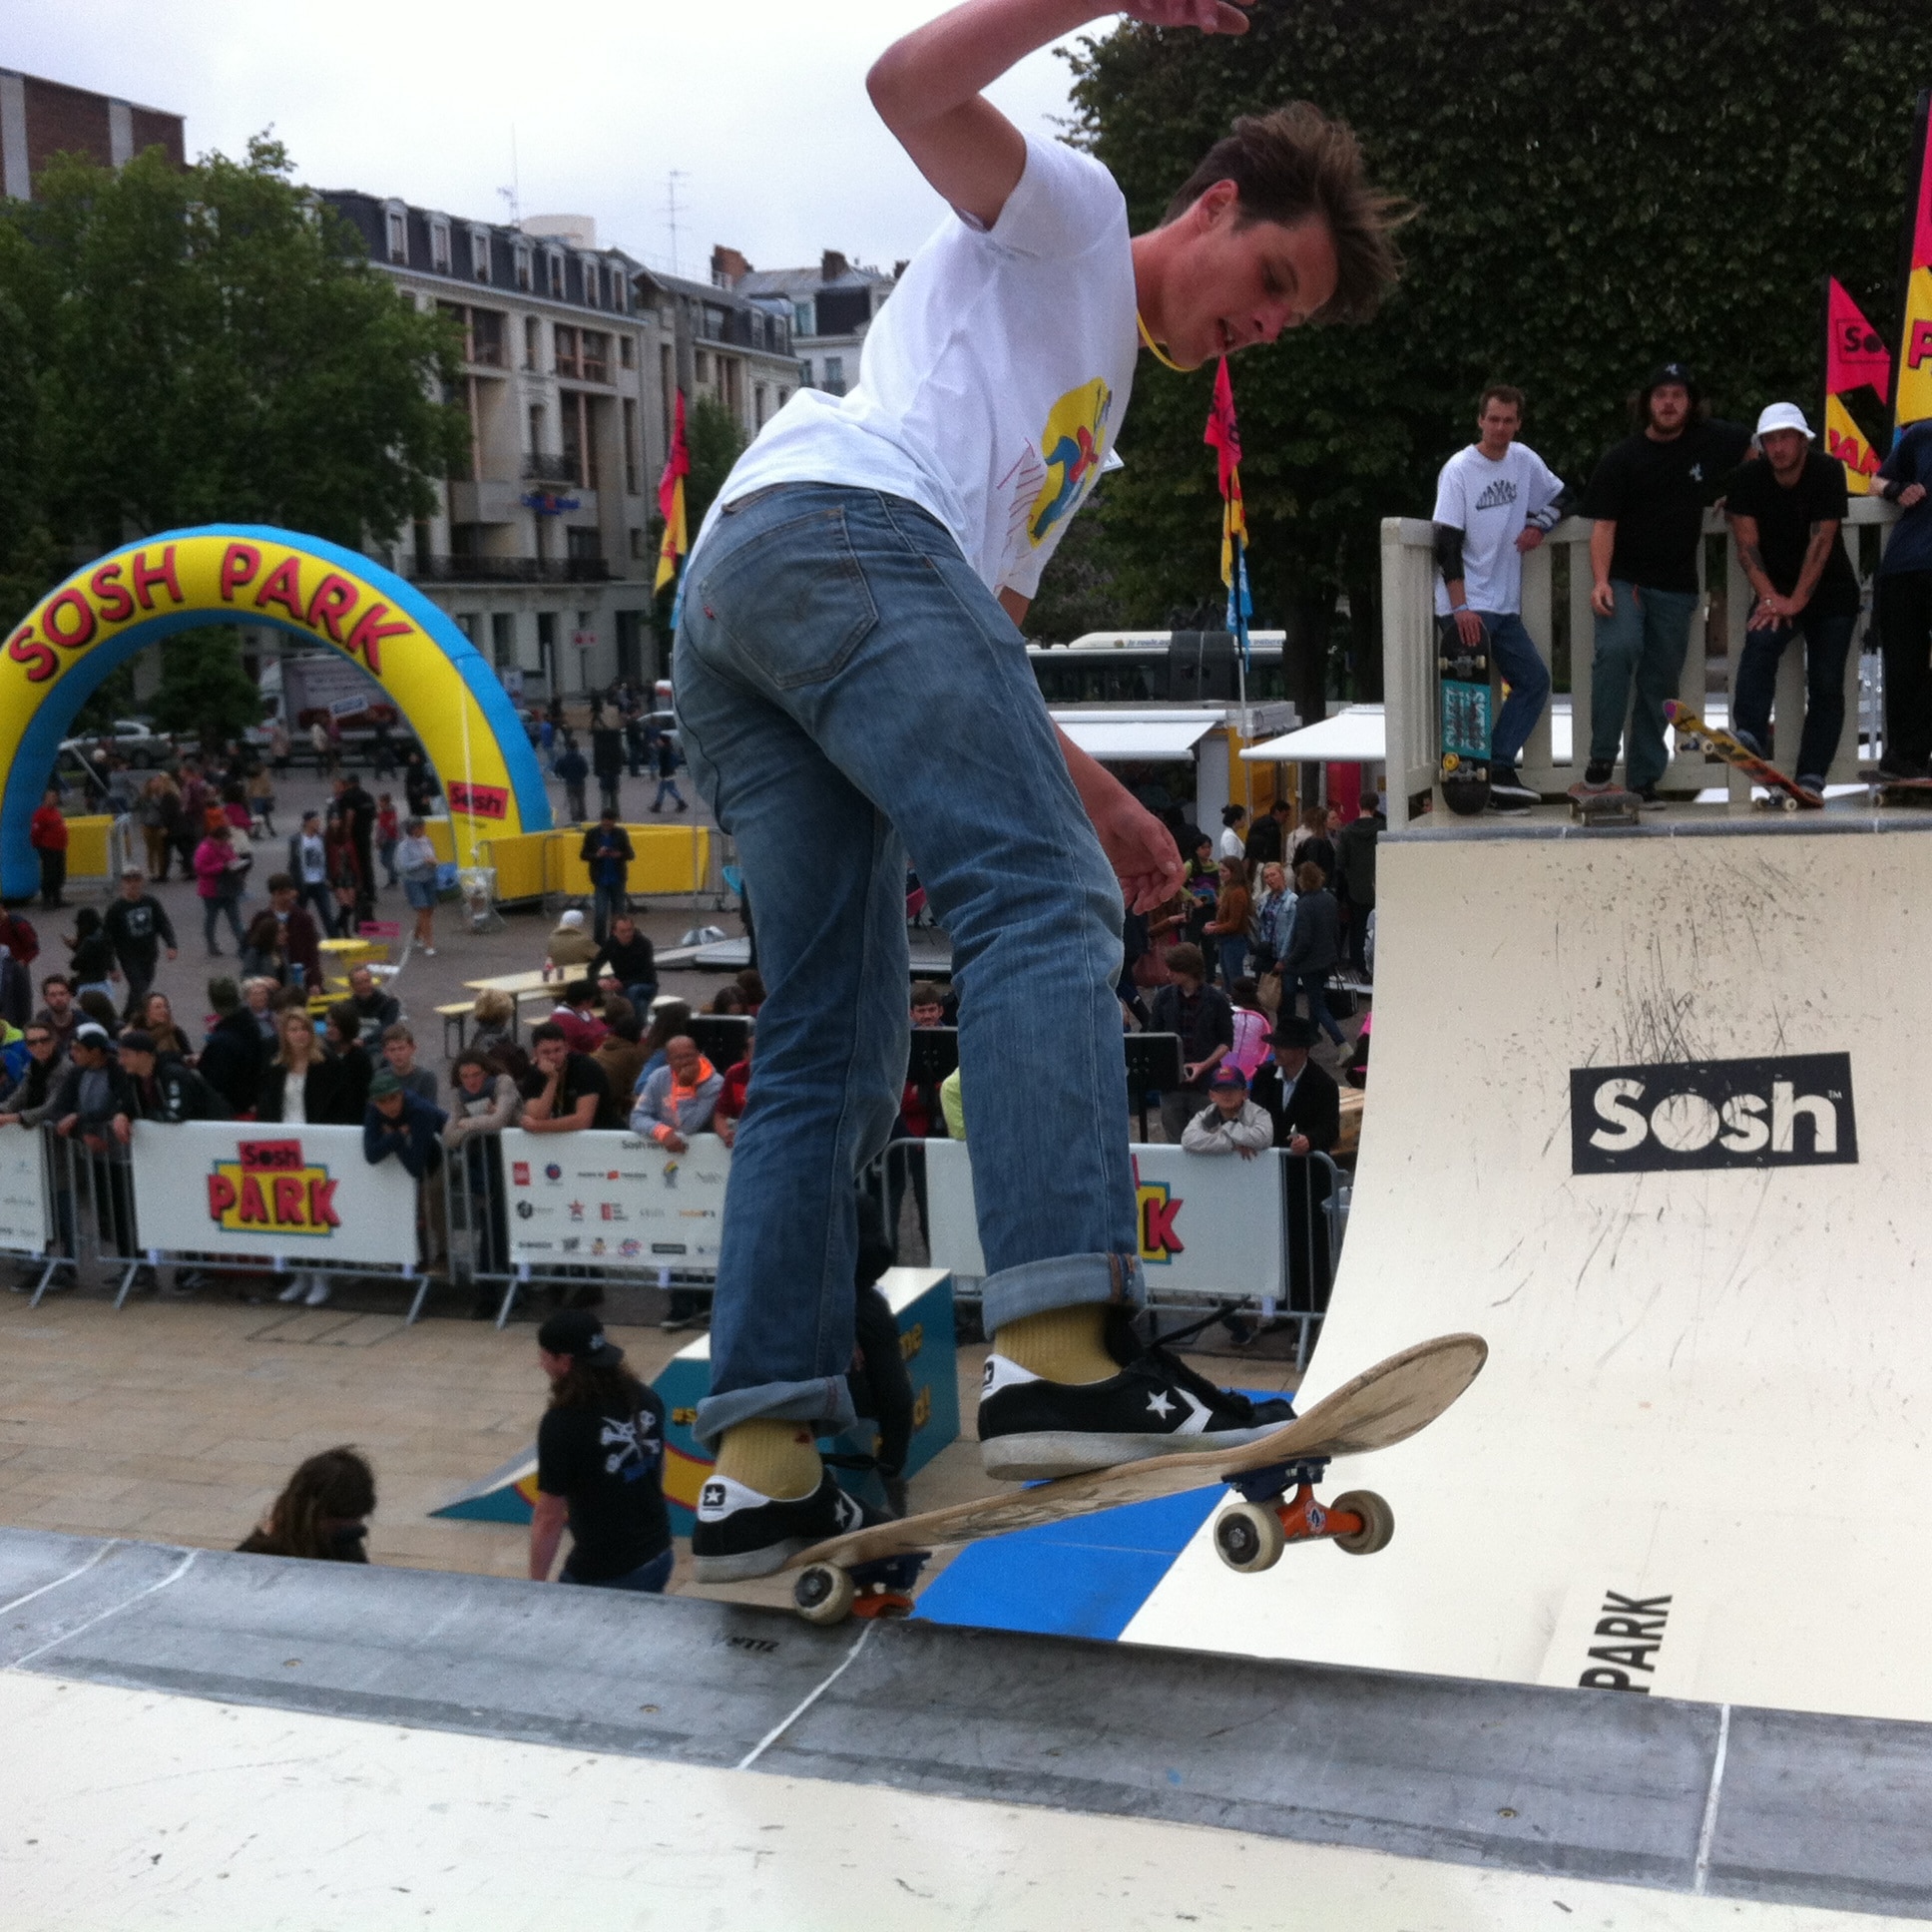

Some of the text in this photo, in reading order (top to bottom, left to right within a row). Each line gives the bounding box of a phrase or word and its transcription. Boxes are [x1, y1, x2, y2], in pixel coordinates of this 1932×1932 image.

[9, 543, 413, 682] SOSH PARK
[451, 785, 501, 813] Sosh
[1588, 1078, 1838, 1154] Sosh
[244, 1144, 298, 1166] Sosh
[208, 1174, 341, 1227] PARK
[1578, 1589, 1674, 1693] PARK
